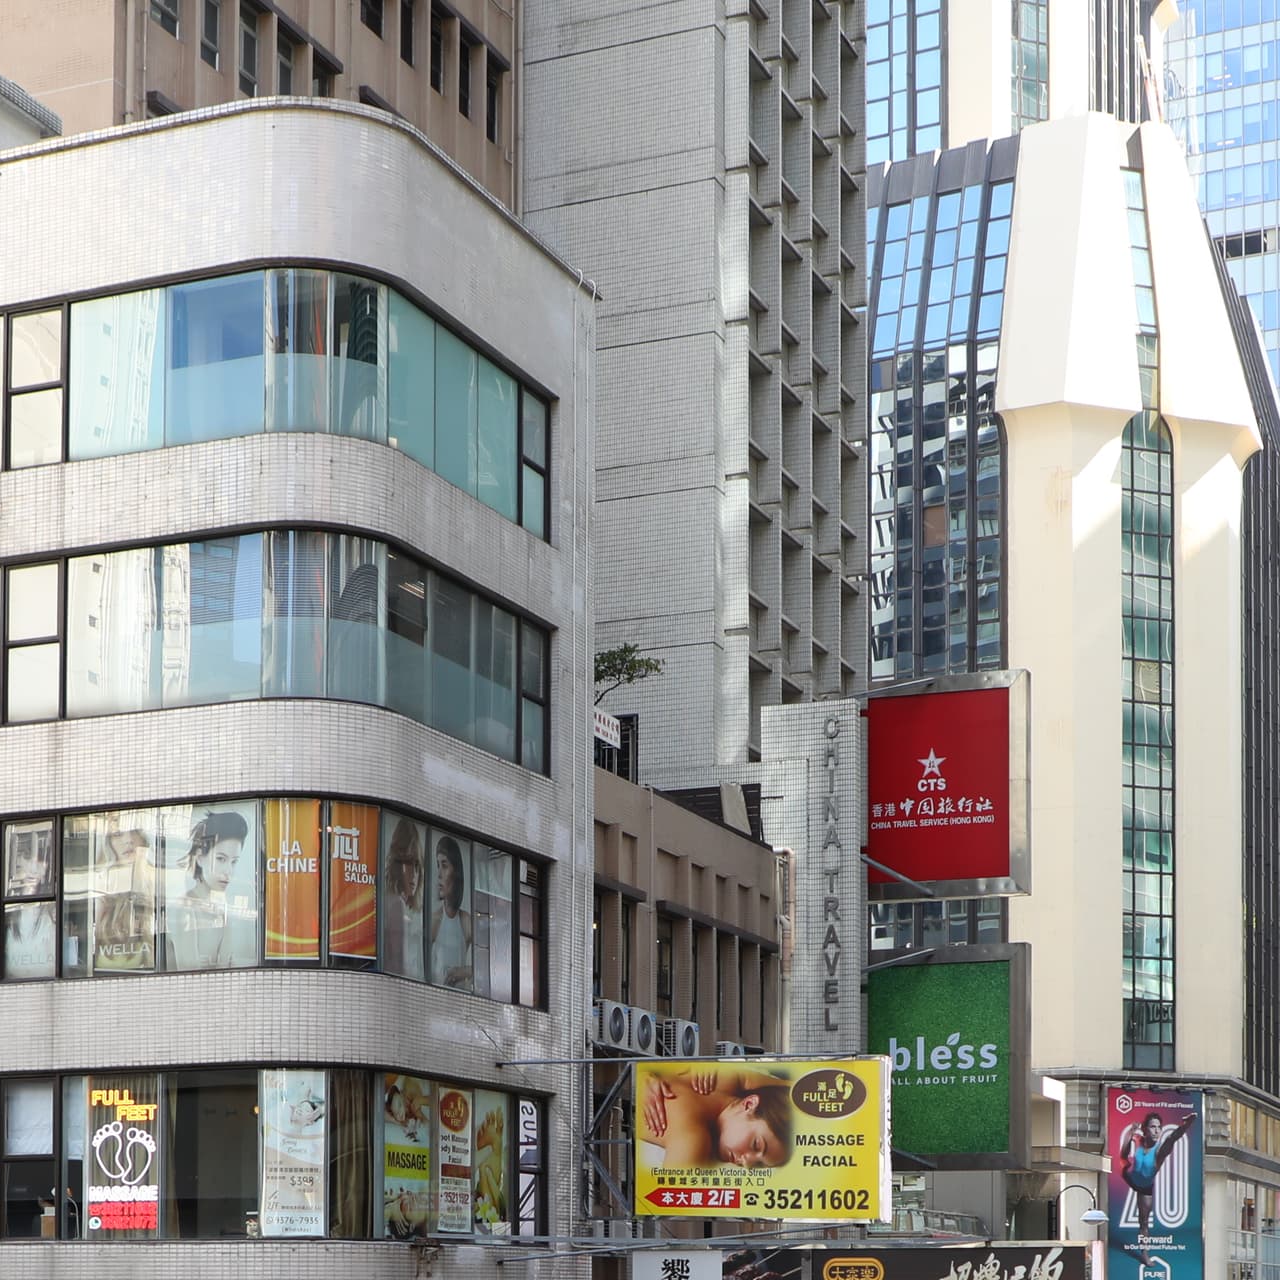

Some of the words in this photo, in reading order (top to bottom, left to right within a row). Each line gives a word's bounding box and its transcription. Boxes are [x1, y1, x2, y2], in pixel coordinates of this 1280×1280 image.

[823, 715, 841, 849] CHINA
[917, 778, 946, 792] CTS
[871, 821, 891, 830] CHINA
[893, 819, 918, 829] TRAVEL
[920, 817, 948, 827] SERVICE
[949, 815, 971, 826] (HONG
[972, 814, 994, 824] KONG)
[281, 840, 302, 856] LA
[266, 857, 318, 874] CHINE
[344, 861, 368, 875] HAIR
[344, 872, 376, 885] SALON
[99, 942, 150, 956] WELLA
[823, 868, 841, 1032] TRAVEL
[916, 1076, 956, 1085] ABOUT
[962, 1073, 998, 1084] FRUIT
[91, 1089, 135, 1106] FULL
[803, 1091, 829, 1103] FULL
[116, 1104, 158, 1121] FEET
[818, 1102, 845, 1113] FEET
[795, 1134, 865, 1146] MASSAGE
[387, 1150, 427, 1171] MASSAGE
[803, 1155, 857, 1167] FACIAL
[651, 1168, 685, 1177] (Entrance
[686, 1168, 694, 1176] at
[694, 1168, 718, 1177] Queen
[719, 1168, 747, 1177] Victoria
[747, 1168, 773, 1178] Street)
[88, 1184, 159, 1202] MASSAGE
[707, 1190, 736, 1206] 2/F
[763, 1188, 870, 1210] 35211602
[1137, 1234, 1173, 1244] Forward
